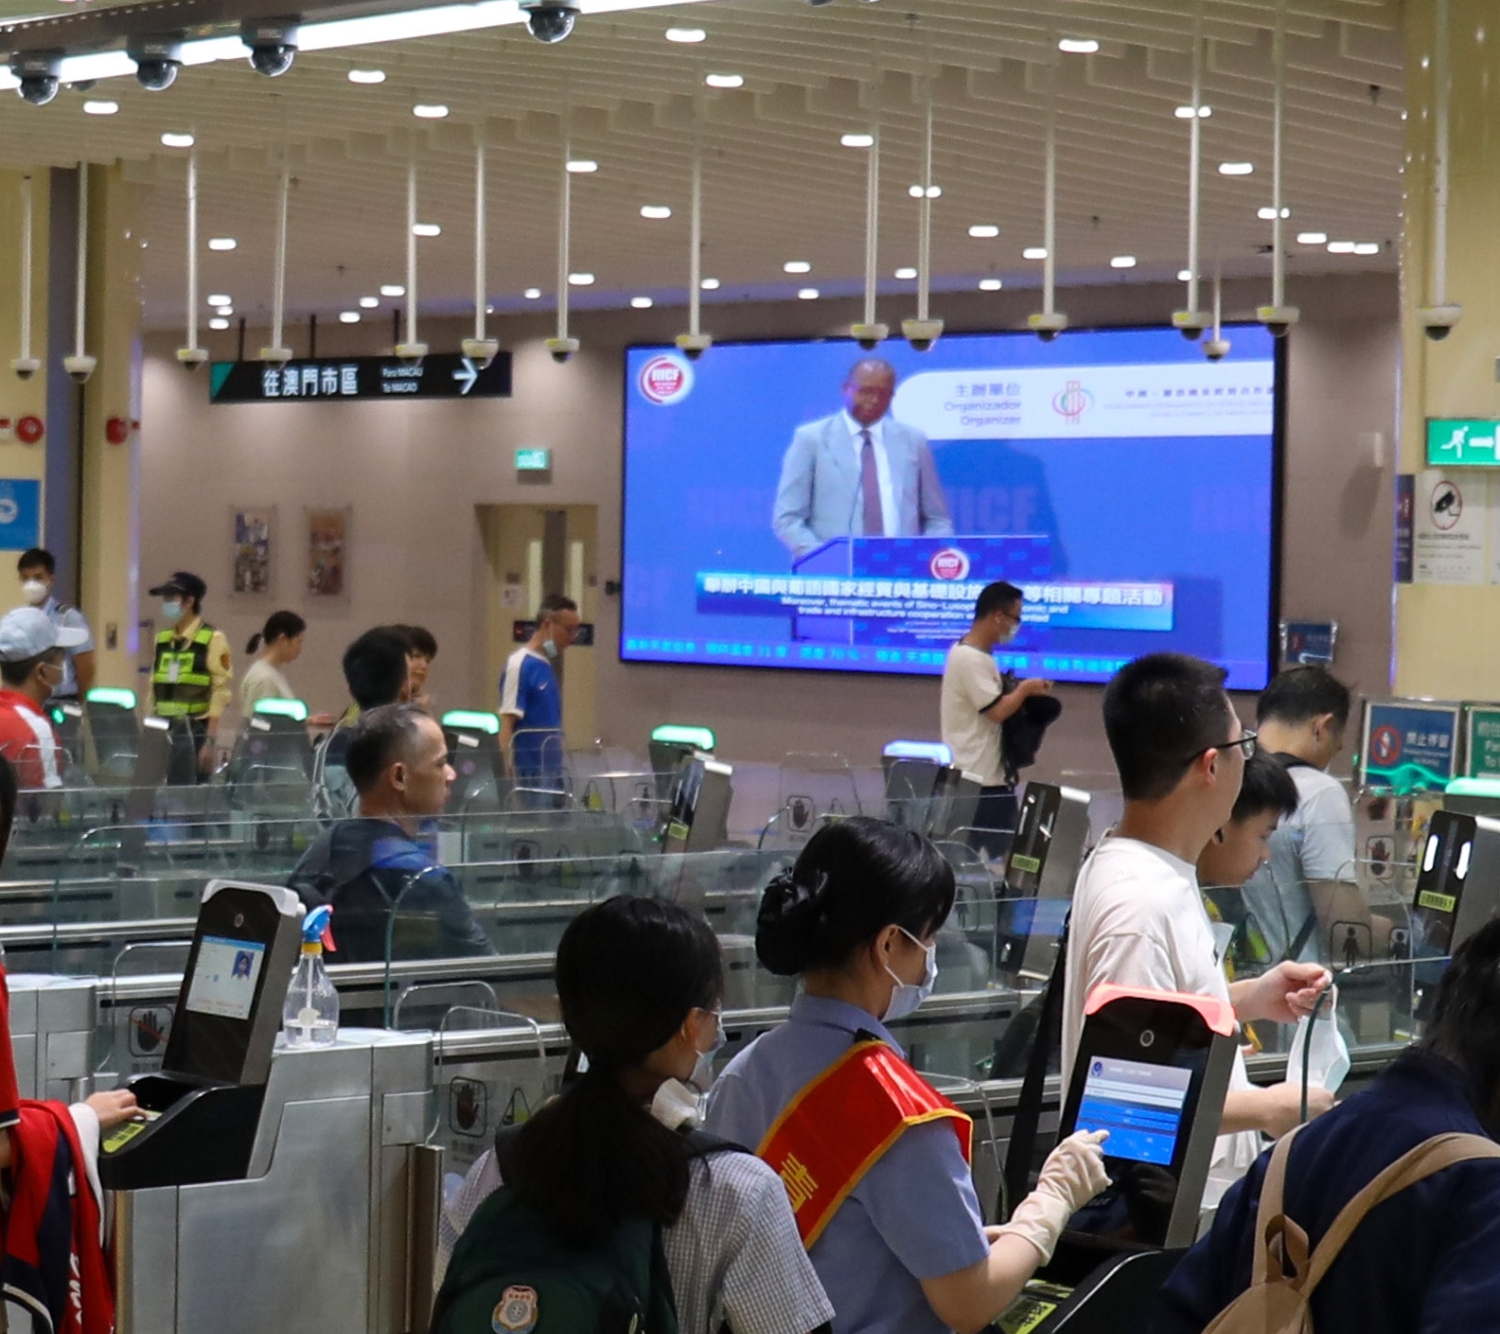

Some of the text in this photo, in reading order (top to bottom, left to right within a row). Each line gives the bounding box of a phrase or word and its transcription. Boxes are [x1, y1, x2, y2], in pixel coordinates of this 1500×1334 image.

[263, 367, 358, 397] 往澳門市區
[704, 577, 1163, 606] 舉辦中國與葡語國家經貿與基礎設施等相關專題活動
[871, 600, 903, 610] events
[904, 600, 915, 610] of
[824, 607, 842, 616] and
[1485, 756, 1496, 767] To
